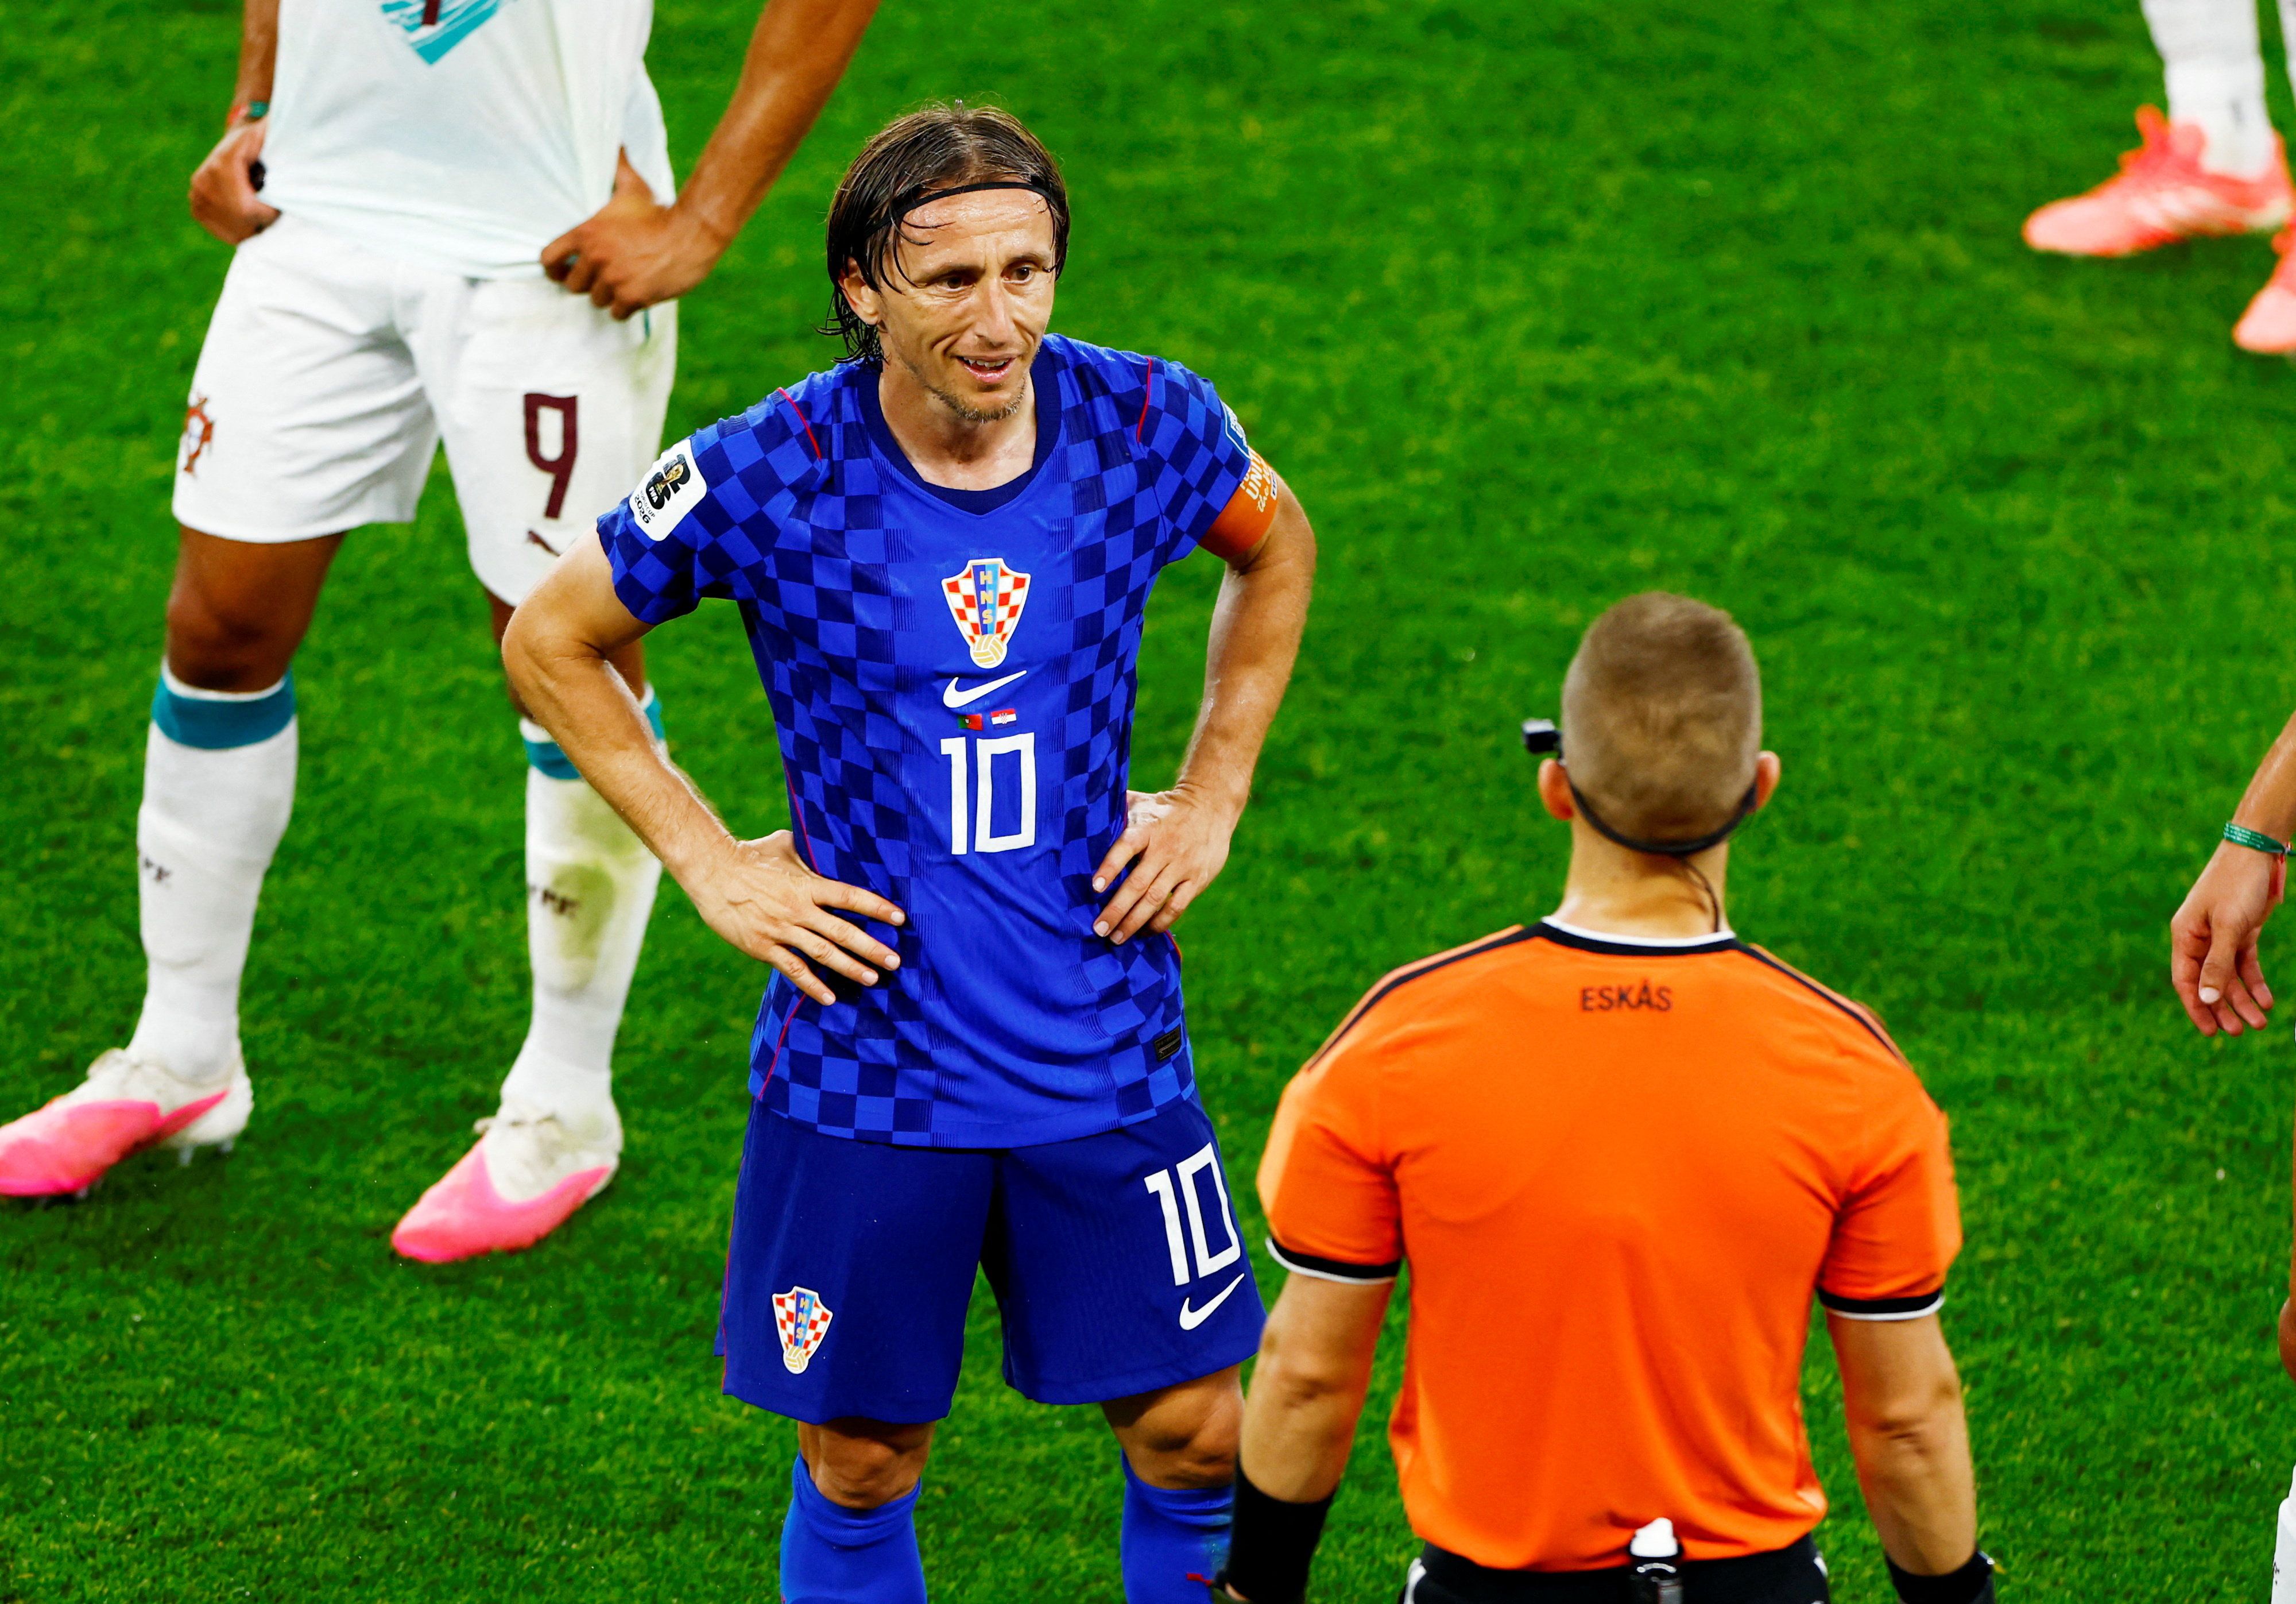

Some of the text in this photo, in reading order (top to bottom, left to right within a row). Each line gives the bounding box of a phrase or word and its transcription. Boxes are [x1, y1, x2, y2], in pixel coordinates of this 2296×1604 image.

[524, 393, 578, 519] 9
[634, 494, 651, 524] 2026
[646, 507, 656, 517] CUP
[648, 486, 658, 503] FIFA
[979, 571, 993, 624] HNS
[940, 732, 1036, 855] 10
[1581, 977, 1673, 1012] ESKÅS
[1144, 1141, 1241, 1286] 10
[796, 1297, 810, 1339] HNS
